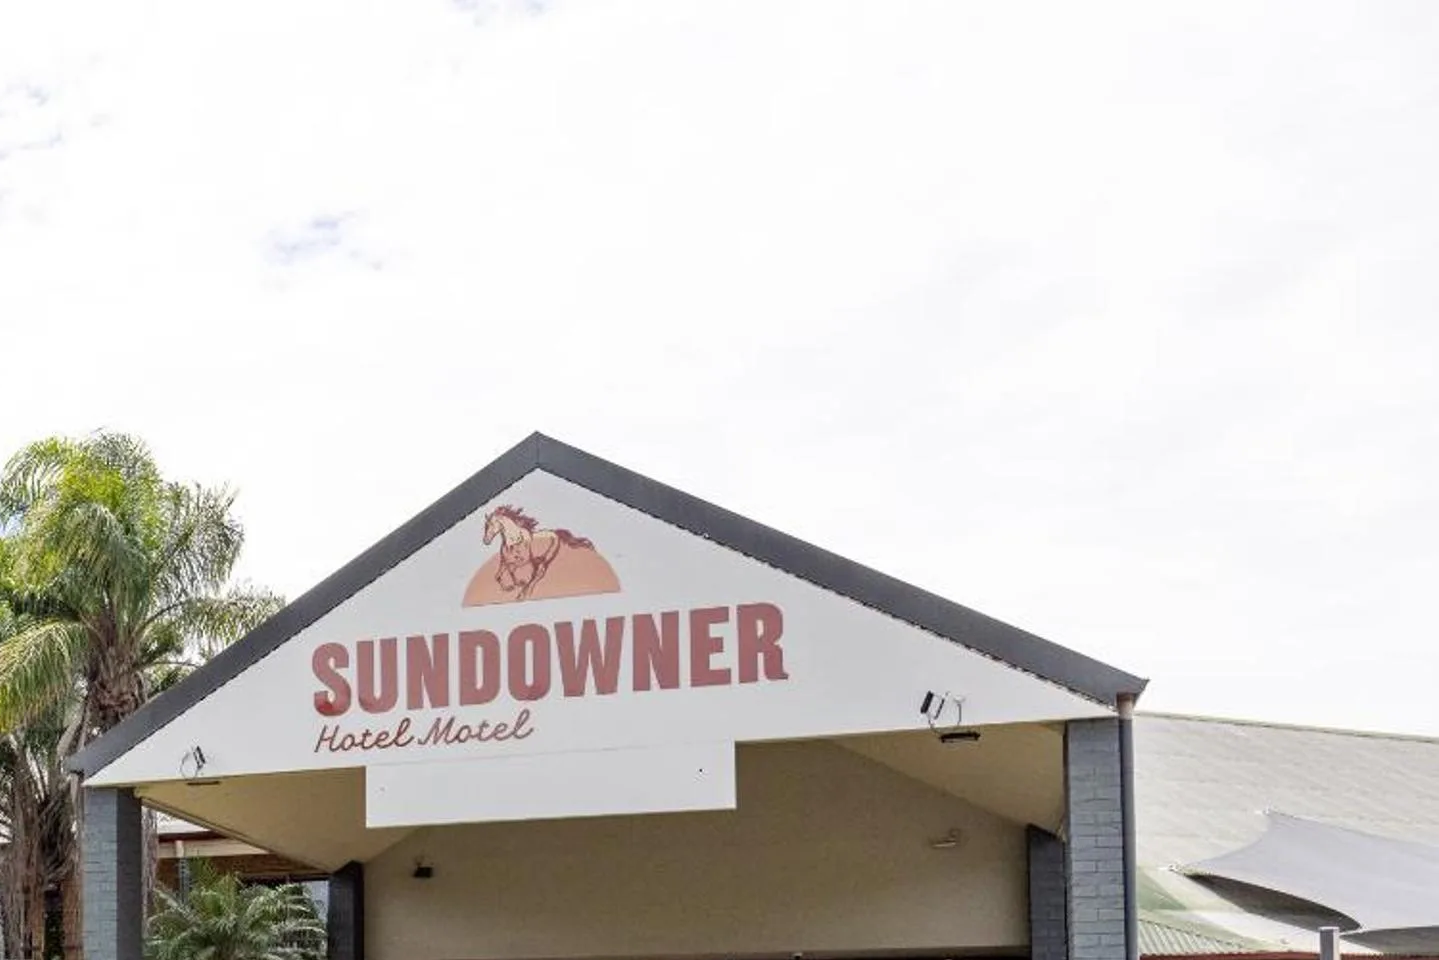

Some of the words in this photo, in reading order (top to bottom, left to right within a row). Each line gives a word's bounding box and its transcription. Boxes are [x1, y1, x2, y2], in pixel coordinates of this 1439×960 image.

[311, 602, 790, 718] SUNDOWNER
[314, 717, 414, 753] Hotel
[417, 708, 534, 746] Motel
